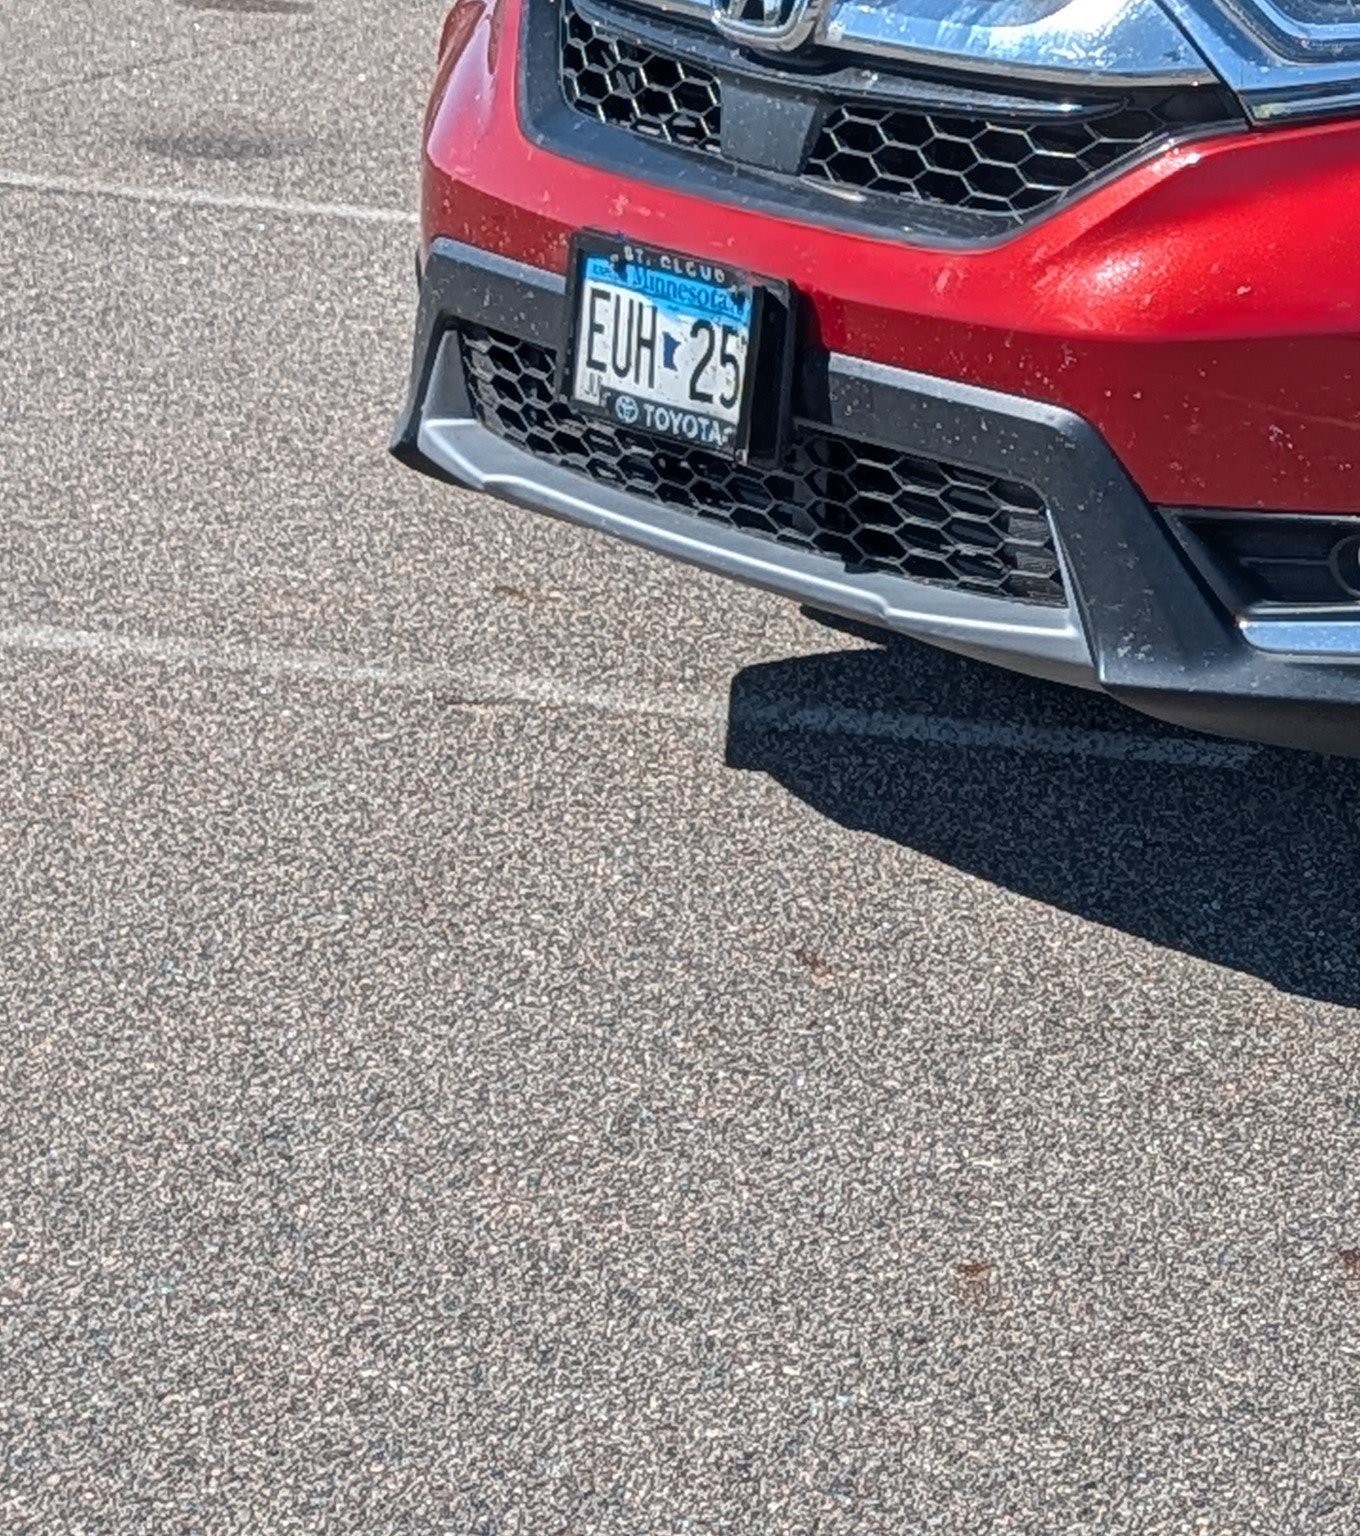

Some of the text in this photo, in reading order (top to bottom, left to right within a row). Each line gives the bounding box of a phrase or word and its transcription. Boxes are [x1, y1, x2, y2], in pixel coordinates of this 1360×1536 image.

[632, 265, 730, 311] Minnesota
[586, 287, 658, 389] EUH
[643, 402, 723, 446] TOYOTA
